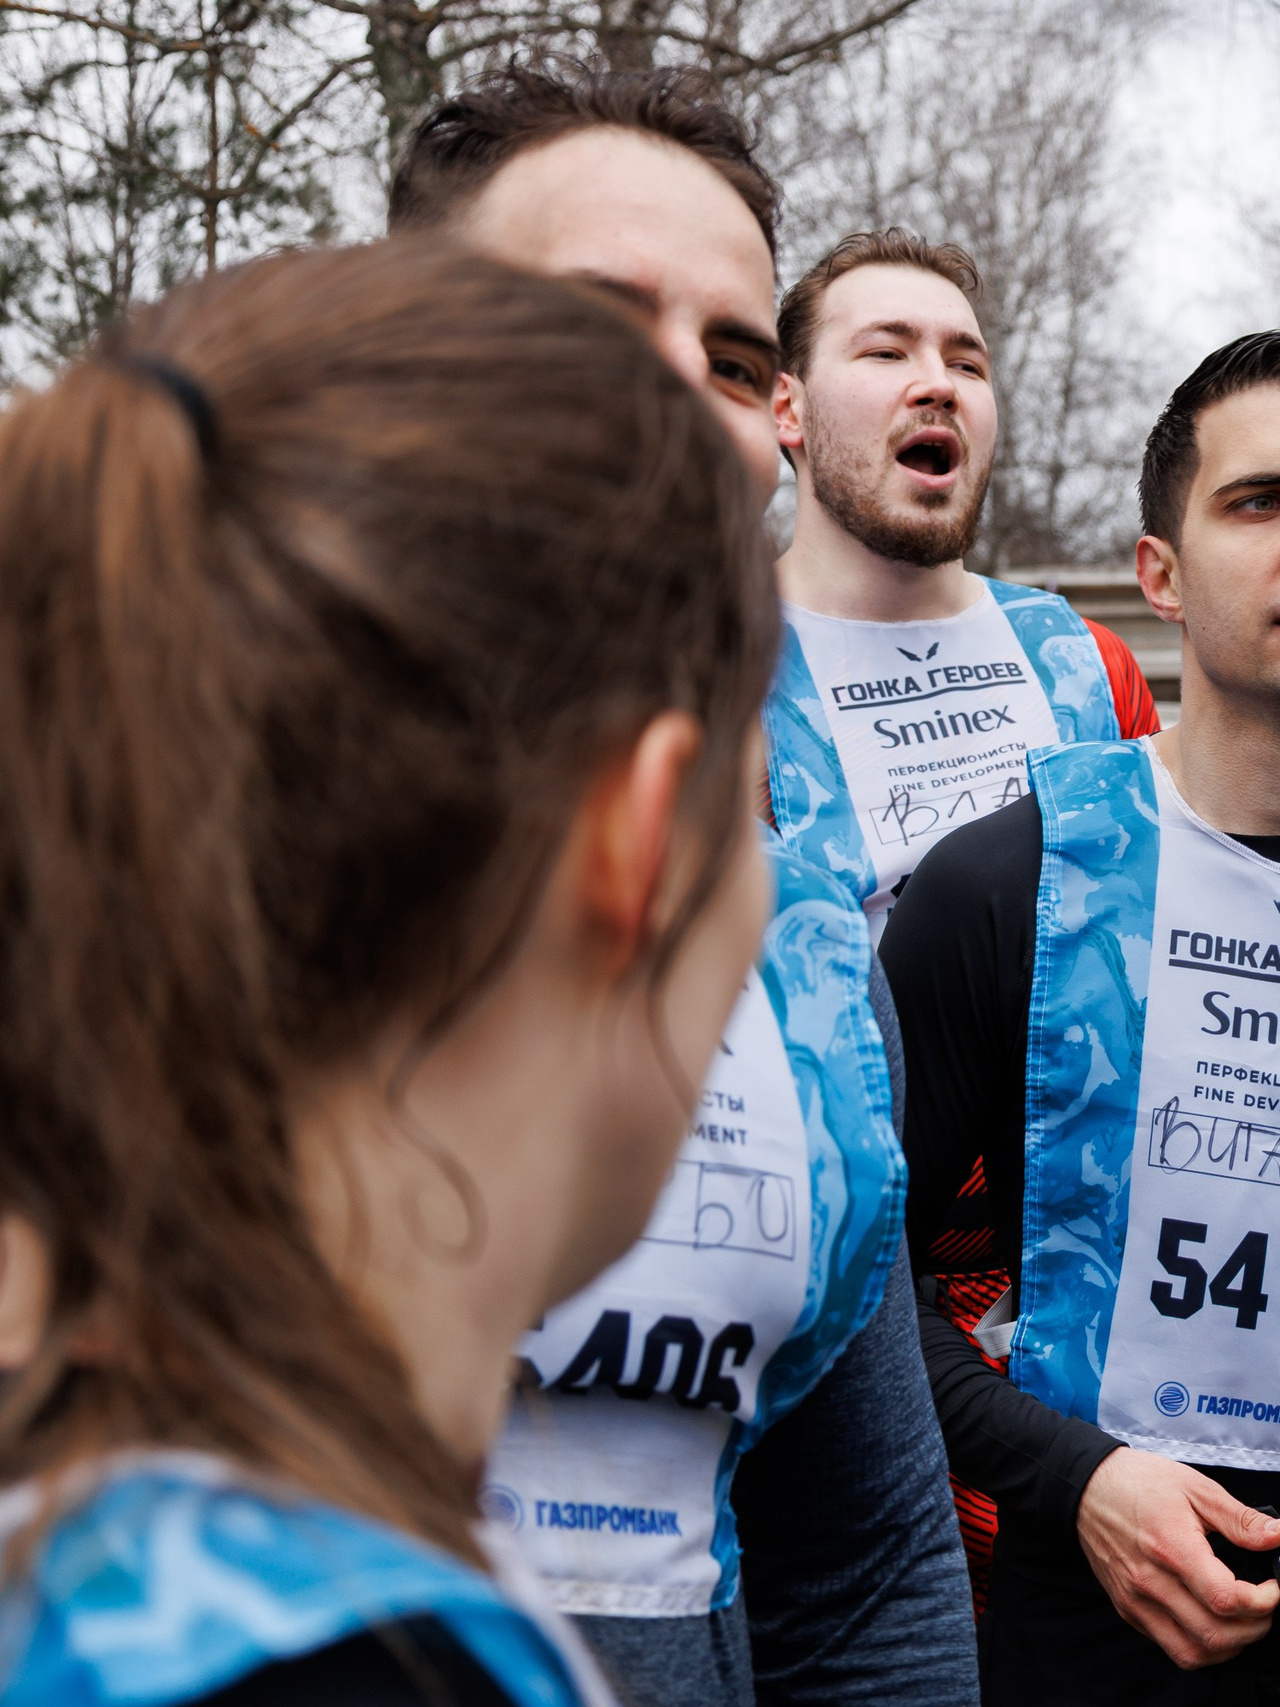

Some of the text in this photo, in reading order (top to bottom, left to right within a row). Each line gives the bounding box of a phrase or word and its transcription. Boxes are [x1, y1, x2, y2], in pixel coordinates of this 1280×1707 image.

[831, 662, 1024, 703] ГОНКА ГЕРОЕВ
[873, 704, 1016, 750] Sminex
[887, 741, 1028, 778] ПЕРФЕКЦИОНИСТЫ
[893, 781, 926, 794] FINE
[1193, 1085, 1235, 1104] FINE
[517, 1308, 756, 1414] 406
[535, 1500, 682, 1537] ГАЗПРОМБАНК
